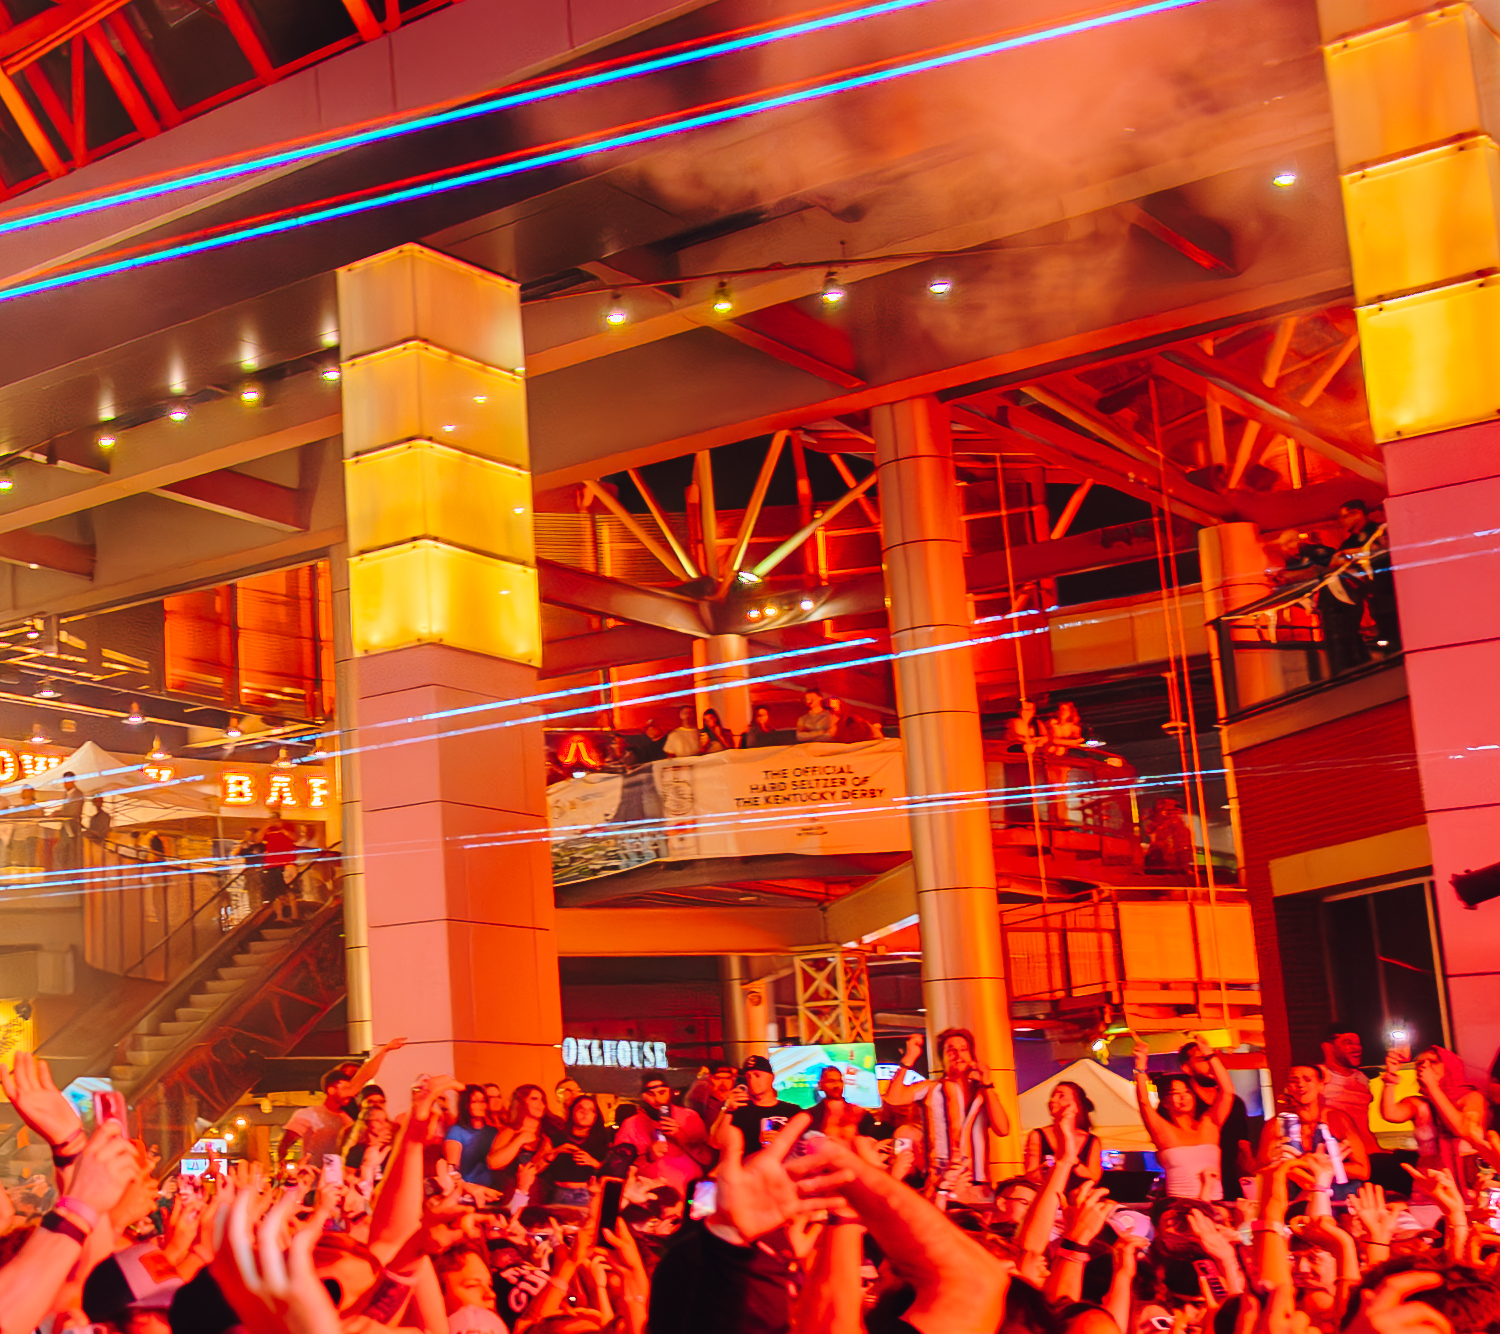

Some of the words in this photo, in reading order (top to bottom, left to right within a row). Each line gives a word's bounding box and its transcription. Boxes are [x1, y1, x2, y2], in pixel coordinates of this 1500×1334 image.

[762, 769, 789, 781] THE
[792, 764, 855, 779] OFFICIAL
[749, 781, 786, 794] HARD
[791, 776, 848, 791] SELTZER
[851, 775, 871, 788] OF
[734, 795, 760, 808] THE
[764, 789, 837, 805] KENTUCKY
[841, 786, 886, 801] DERBY
